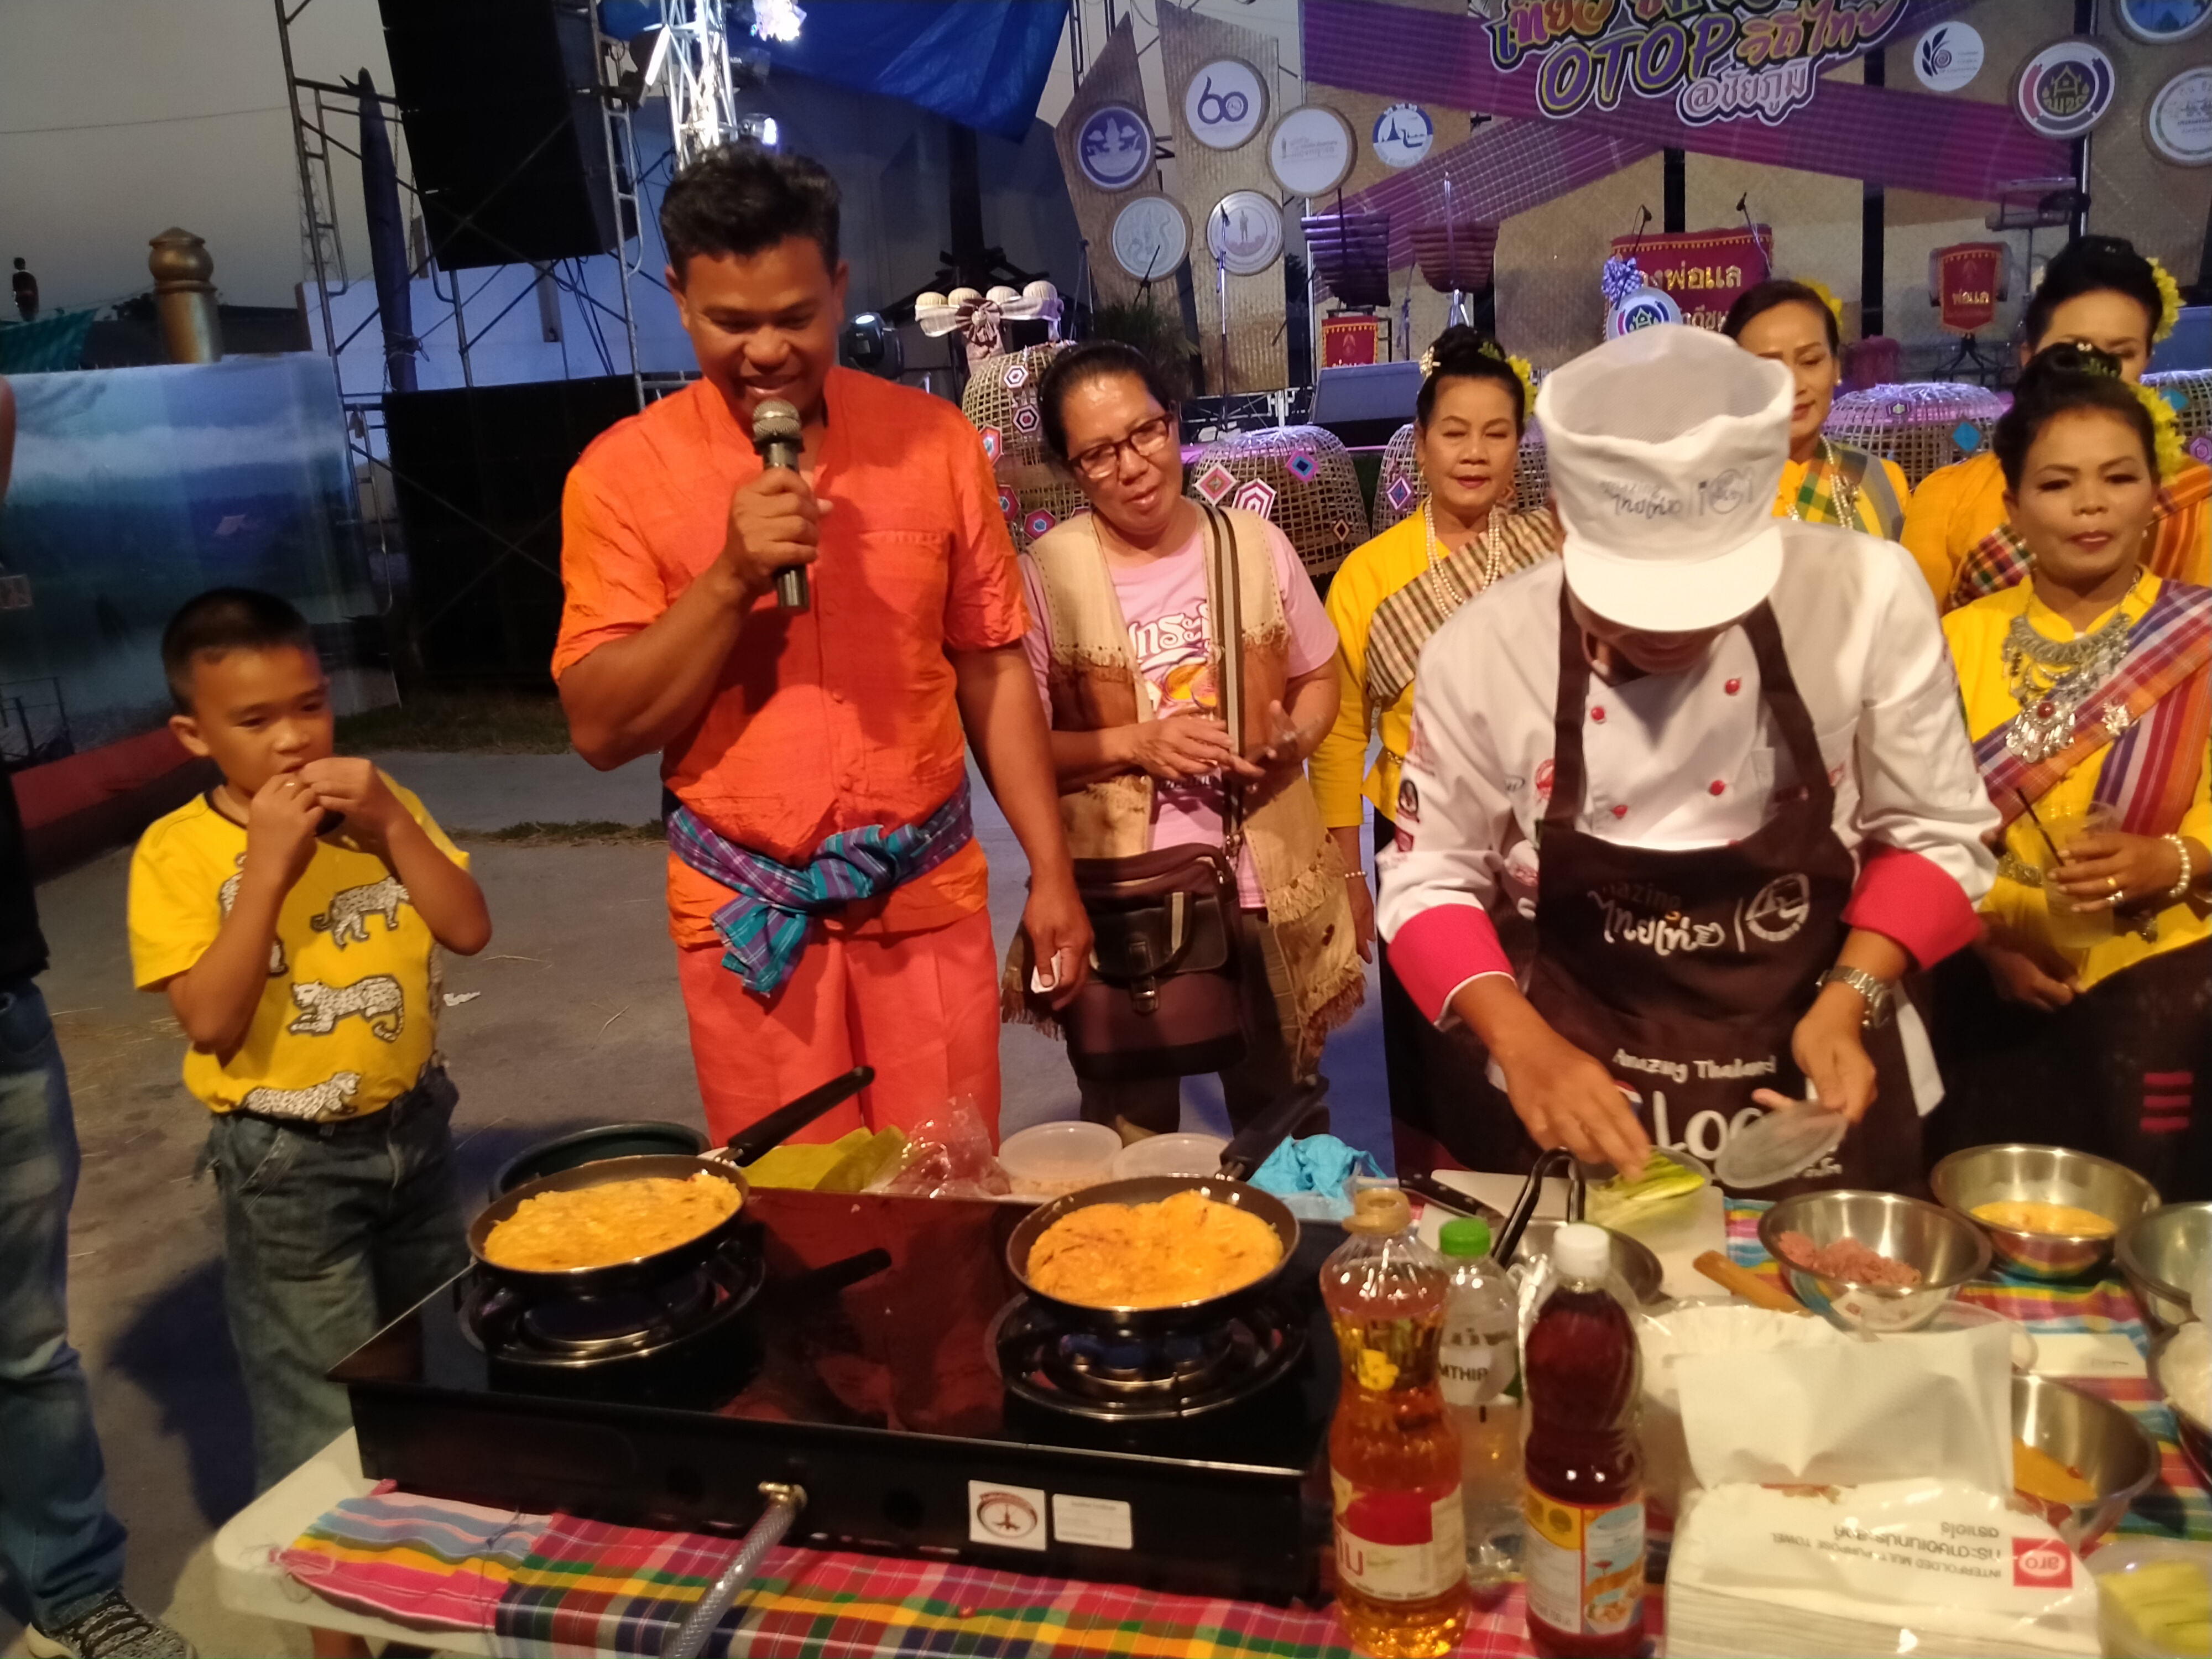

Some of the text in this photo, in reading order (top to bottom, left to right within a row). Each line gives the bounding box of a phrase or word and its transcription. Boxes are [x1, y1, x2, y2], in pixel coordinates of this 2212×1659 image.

[1542, 11, 1736, 109] OTOP
[1197, 76, 1249, 124] 60
[1686, 60, 1807, 110] @ชัยภูมิ
[1612, 1048, 1776, 1084] Amazing Thailand
[1916, 1558, 2001, 1578] INTERFOLDED
[2025, 1556, 2059, 1571] aro
